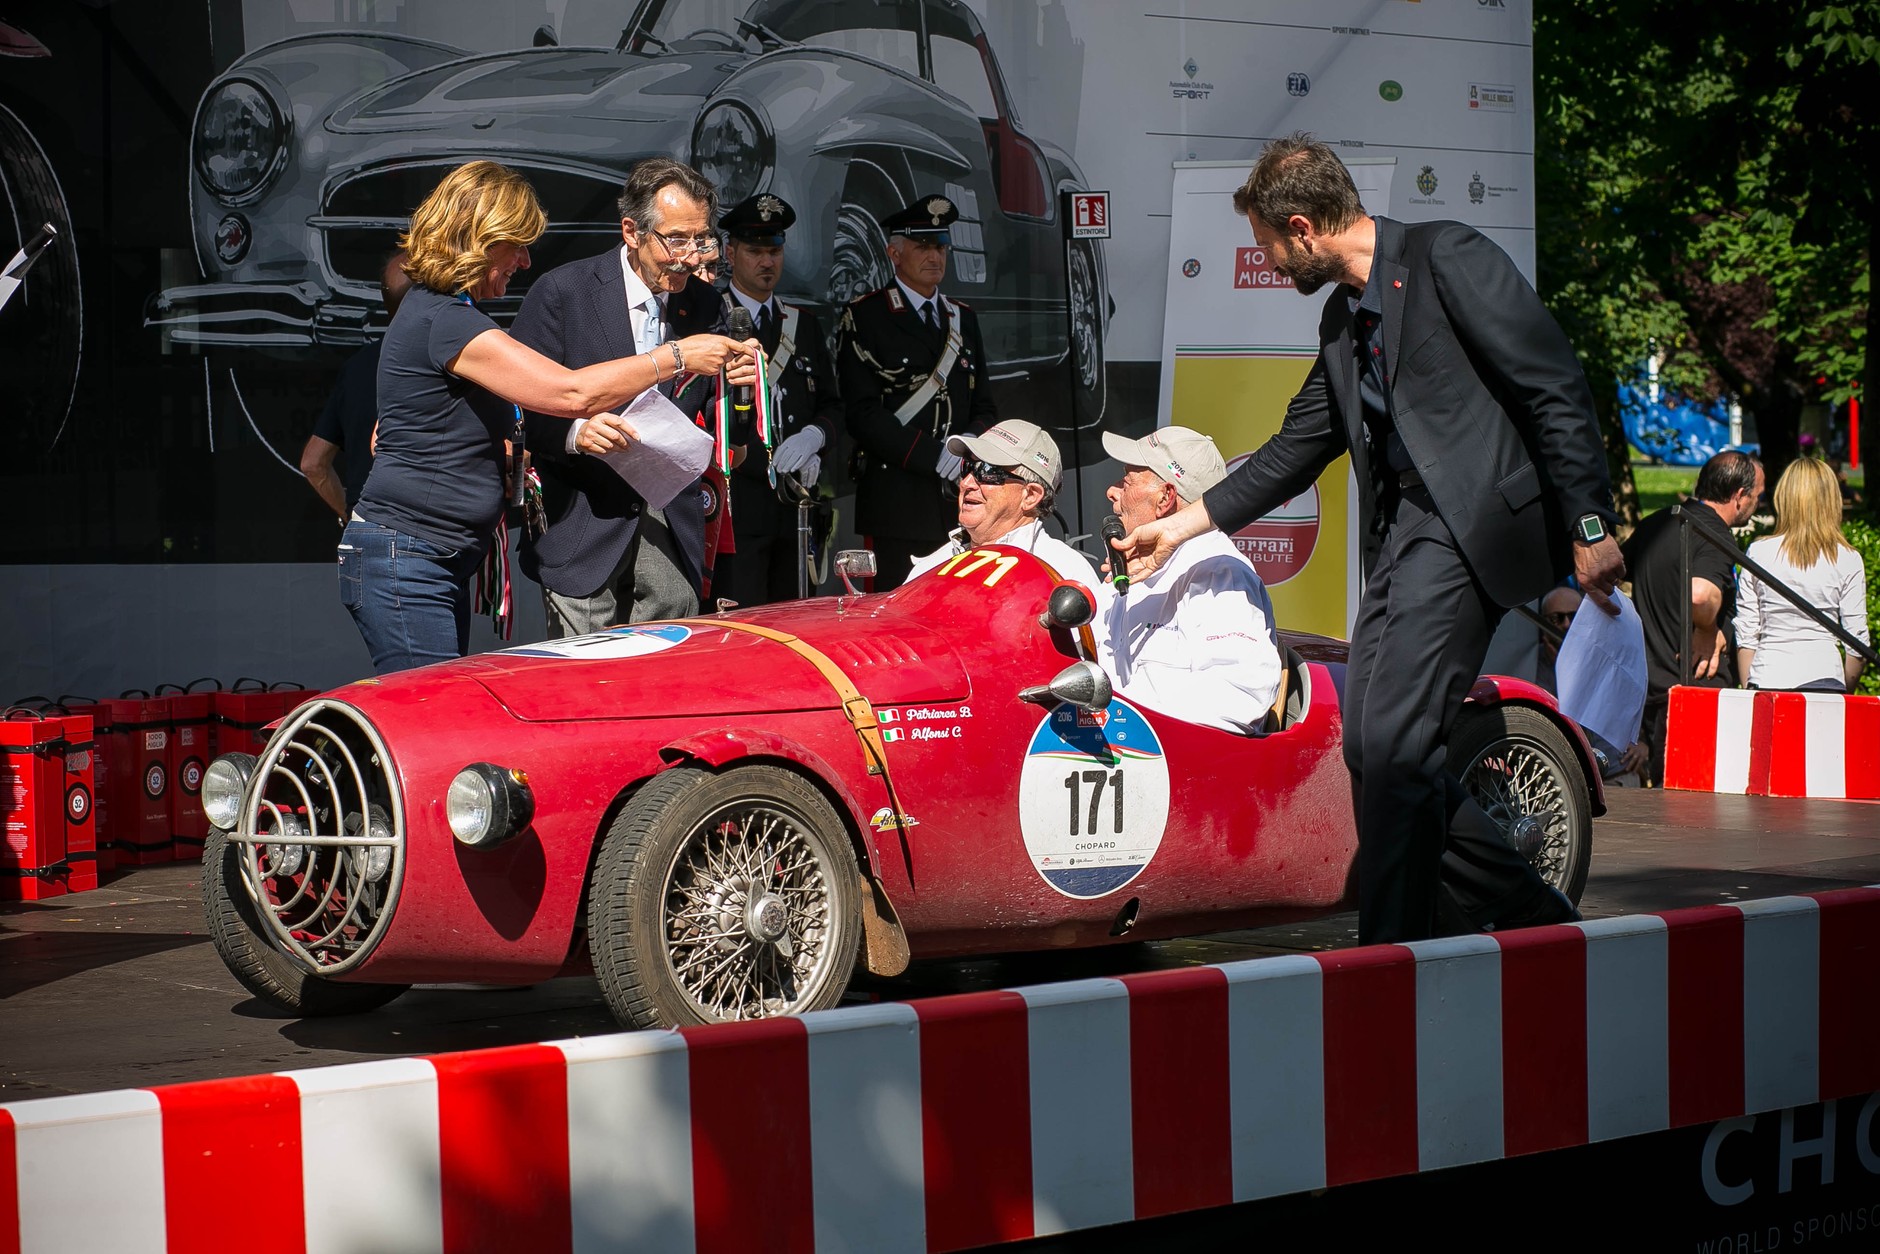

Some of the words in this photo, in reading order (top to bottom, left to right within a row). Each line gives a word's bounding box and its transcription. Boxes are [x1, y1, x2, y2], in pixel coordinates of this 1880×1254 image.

[1332, 26, 1347, 34] SPORT
[1349, 27, 1370, 36] PARTNER
[1288, 77, 1308, 92] FIA
[1173, 90, 1210, 100] SPORT
[1075, 228, 1106, 236] ESTINTORE
[1243, 251, 1266, 266] 10
[1036, 451, 1050, 463] 2016
[1171, 460, 1186, 476] 2016
[1236, 538, 1294, 553] errari
[1248, 552, 1293, 563] IBUTE
[937, 550, 1019, 588] 171
[906, 707, 958, 721] Patriarca
[959, 706, 973, 718] B.
[1057, 711, 1073, 722] 2016
[1079, 717, 1103, 725] MIGLIA
[911, 727, 950, 741] Alfonsi
[153, 776, 160, 785] 52
[189, 772, 197, 780] 52
[74, 799, 82, 808] 52
[1064, 769, 1124, 836] 171
[1075, 841, 1116, 850] CHOPARD
[1697, 1227, 1781, 1254] WORLD
